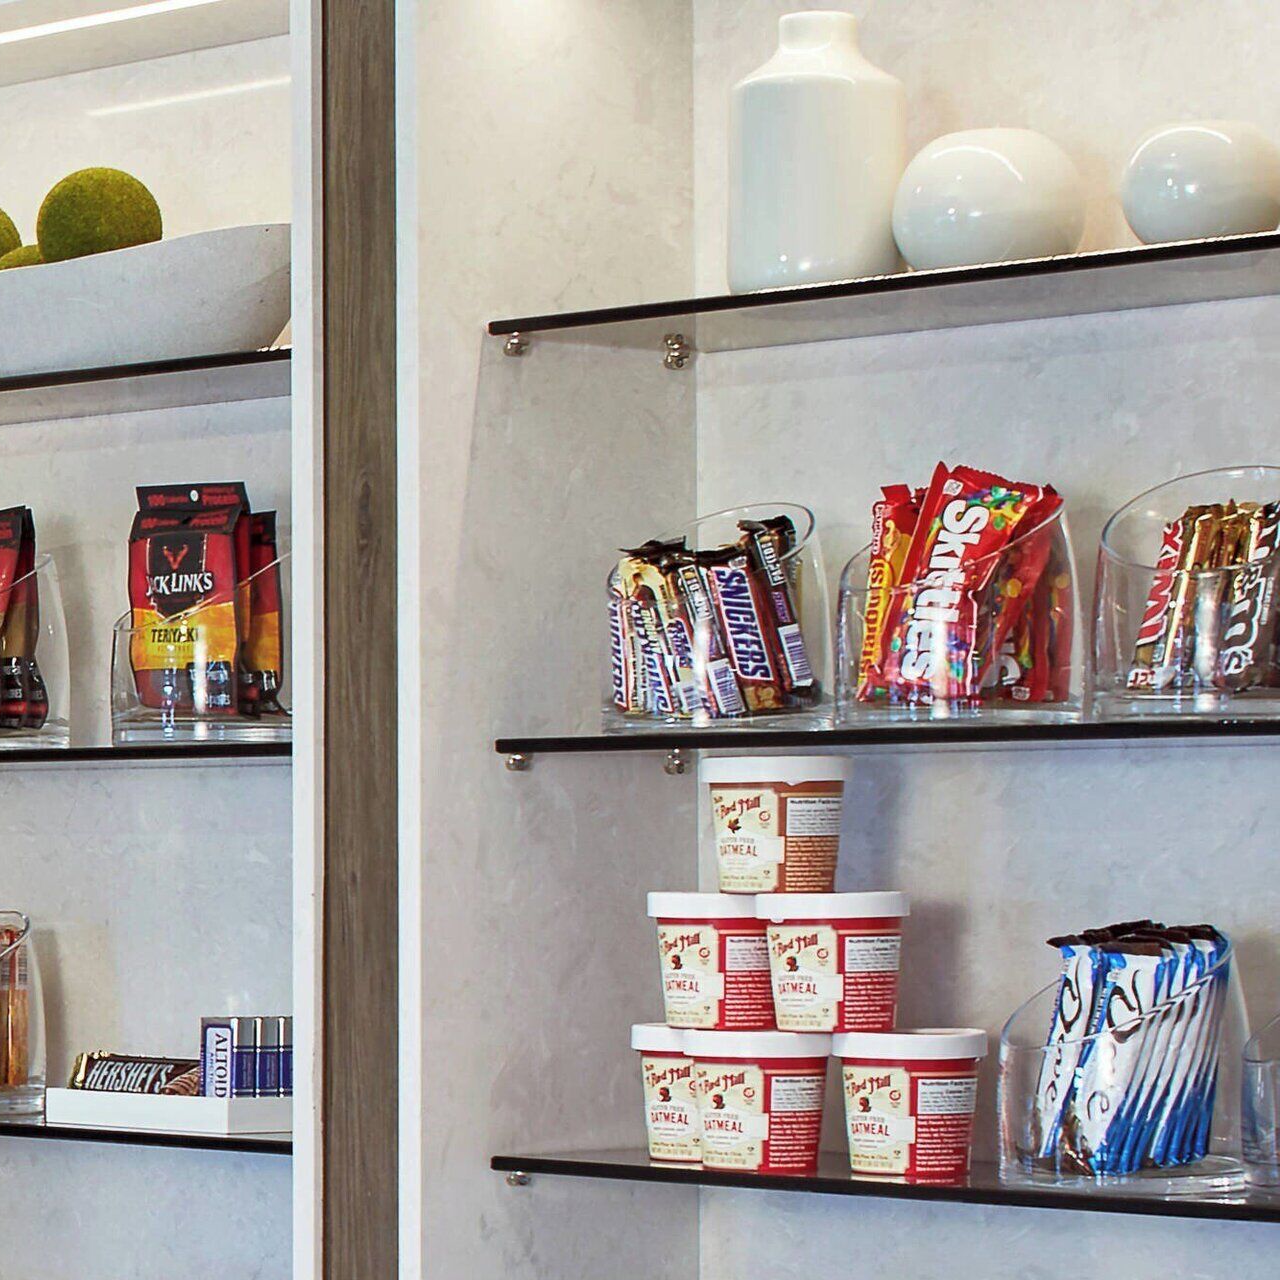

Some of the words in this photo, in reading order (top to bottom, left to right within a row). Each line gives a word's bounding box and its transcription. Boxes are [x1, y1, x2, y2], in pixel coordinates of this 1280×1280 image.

[900, 499, 990, 682] Skittles
[714, 568, 772, 681] SNICKERS
[720, 801, 737, 818] Red
[738, 796, 760, 815] Mill
[663, 939, 678, 954] Red
[680, 933, 700, 952] Mill
[778, 942, 793, 957] Red
[795, 933, 818, 955] Mill
[214, 1033, 228, 1098] ALTOID
[651, 1072, 667, 1087] Red
[669, 1065, 690, 1085] Mill
[704, 1078, 721, 1094] Red
[722, 1072, 745, 1092] Mill
[850, 1081, 867, 1097] Red
[869, 1074, 891, 1095] Mill
